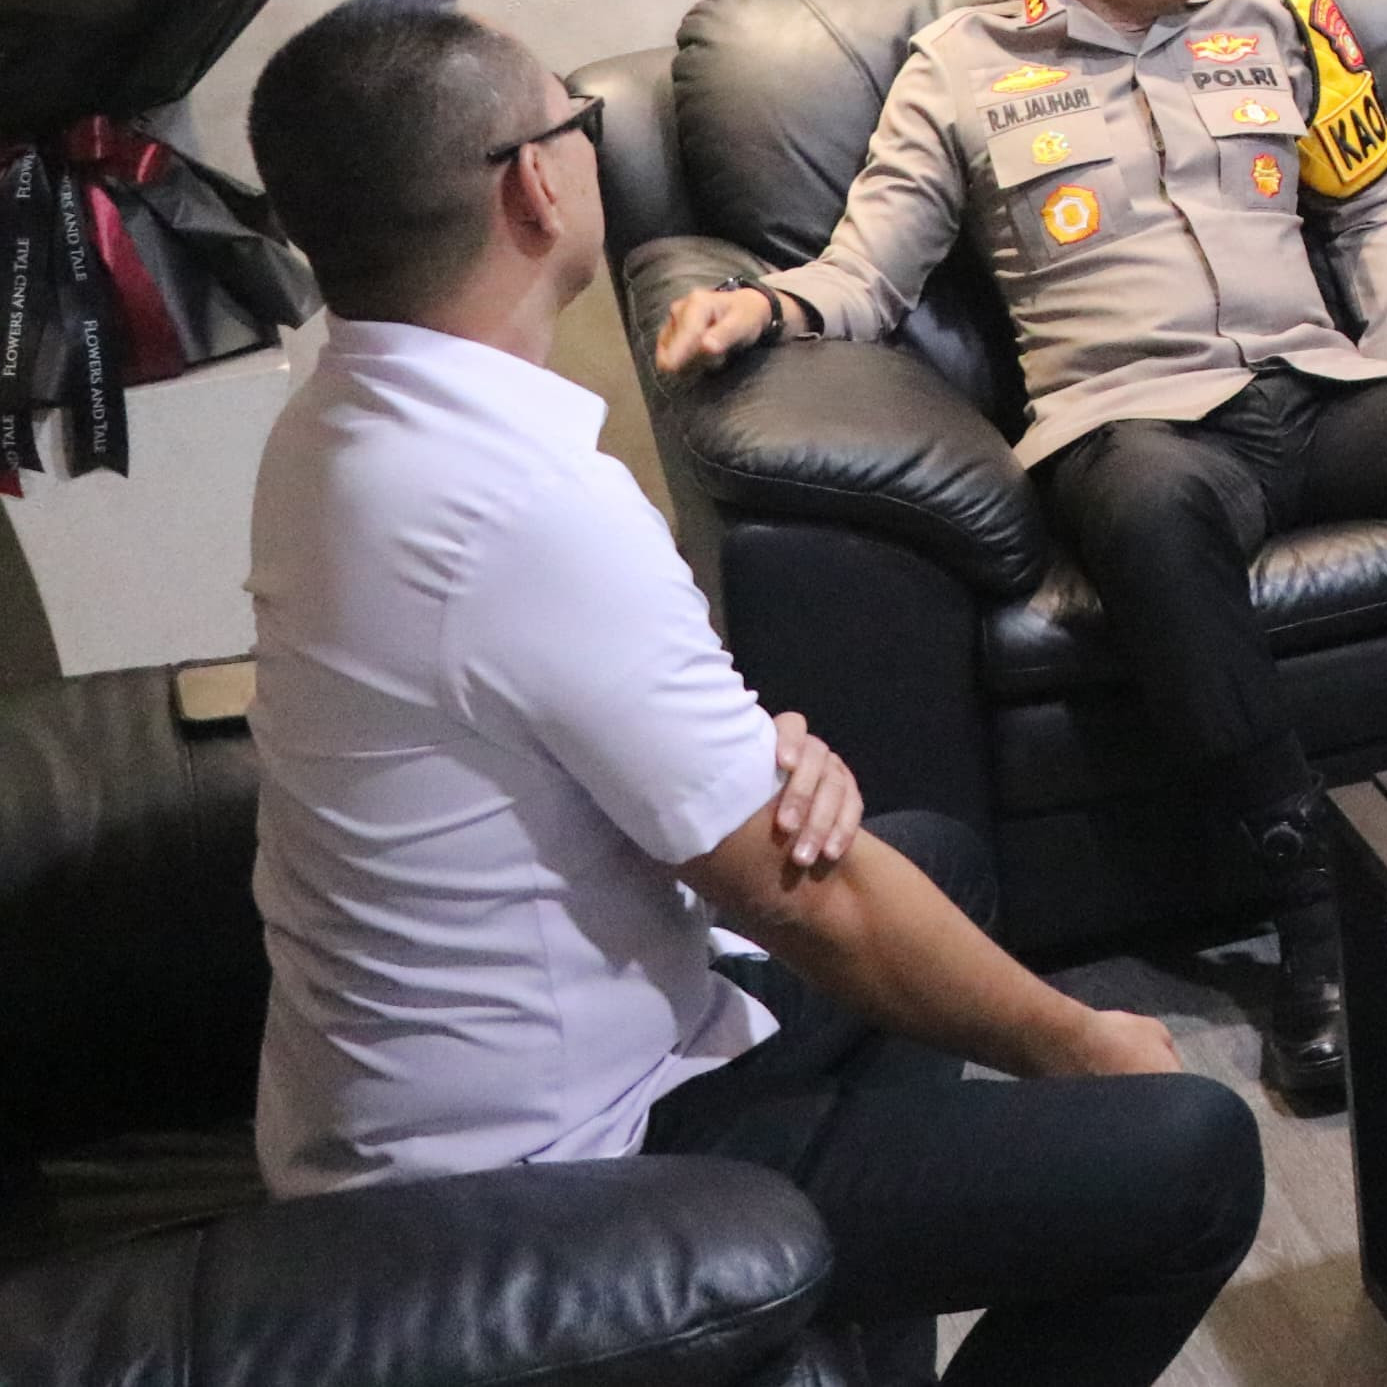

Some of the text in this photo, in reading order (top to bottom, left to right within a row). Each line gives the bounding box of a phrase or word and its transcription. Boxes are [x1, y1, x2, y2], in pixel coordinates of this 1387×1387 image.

[1192, 66, 1279, 91] POLRI
[63, 211, 81, 246] AND
[70, 246, 89, 282] TALE
[3, 237, 31, 377] FLOWERS AND TALE
[83, 318, 109, 455] FLOWERS AND TALE
